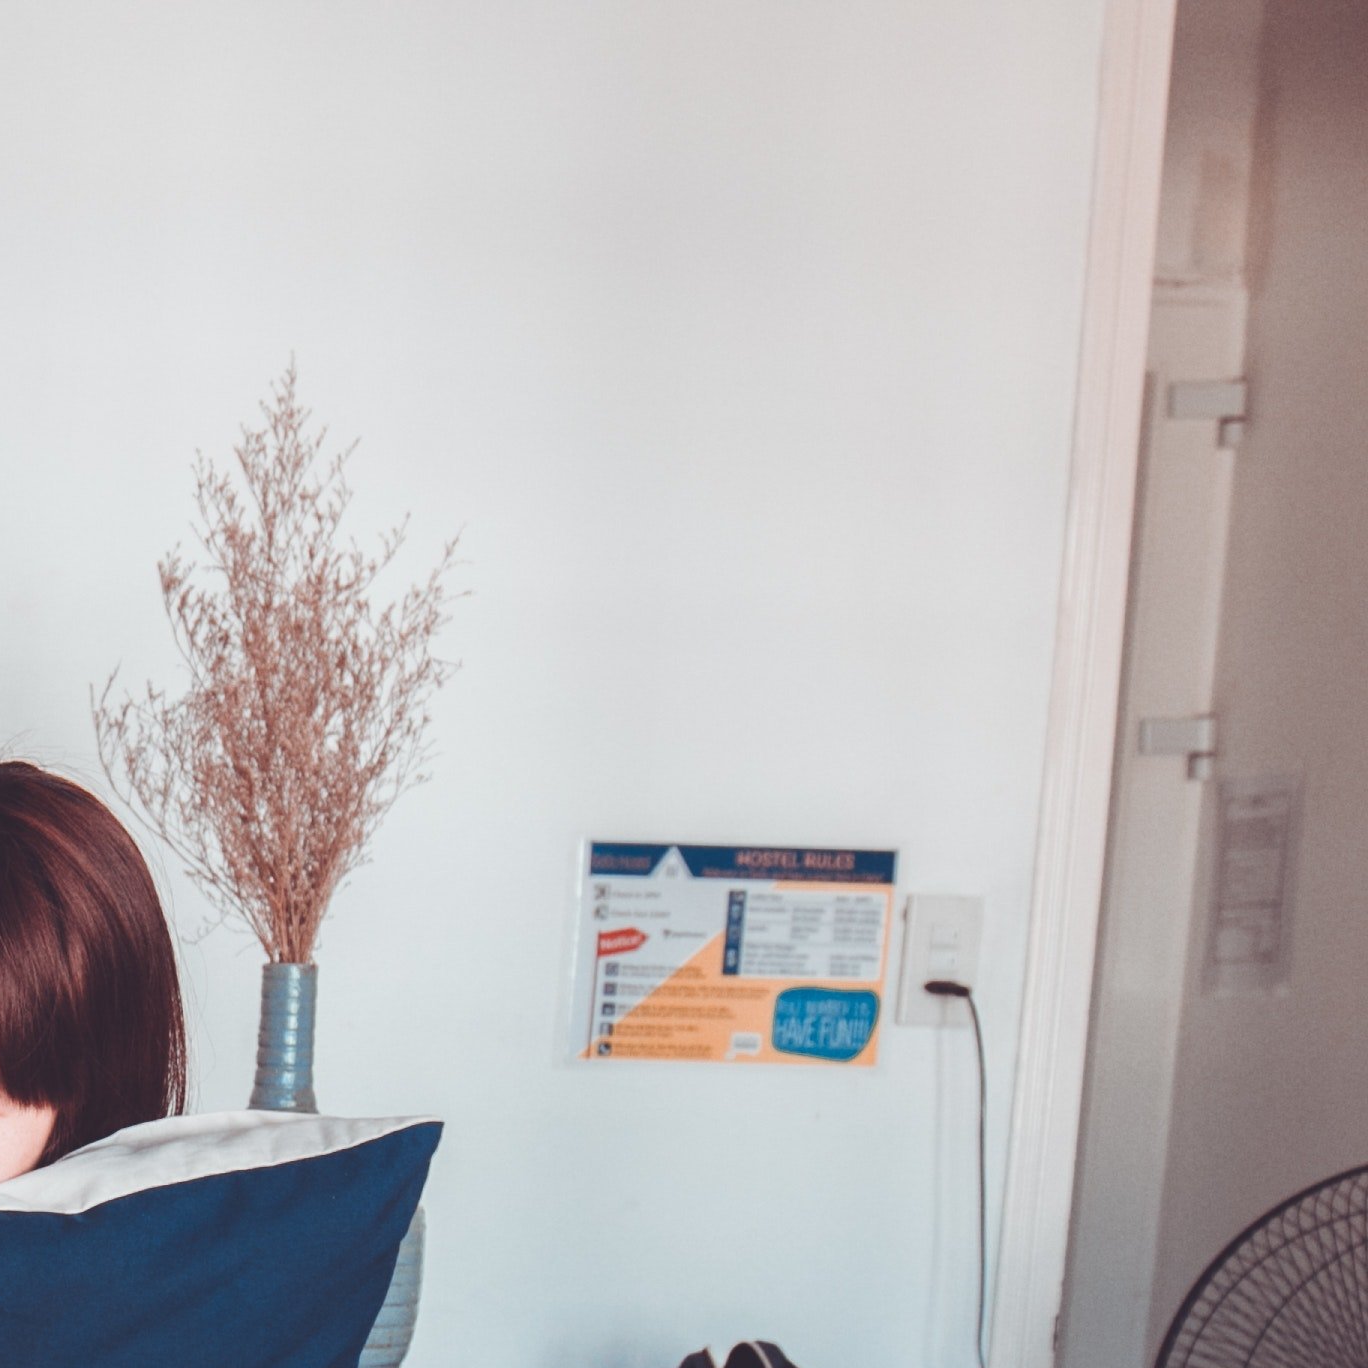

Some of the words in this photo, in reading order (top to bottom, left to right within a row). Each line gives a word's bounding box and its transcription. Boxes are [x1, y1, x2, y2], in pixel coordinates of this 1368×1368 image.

[736, 850, 799, 868] HOSTEL
[805, 851, 856, 870] RULES
[776, 1016, 816, 1049] HAVE
